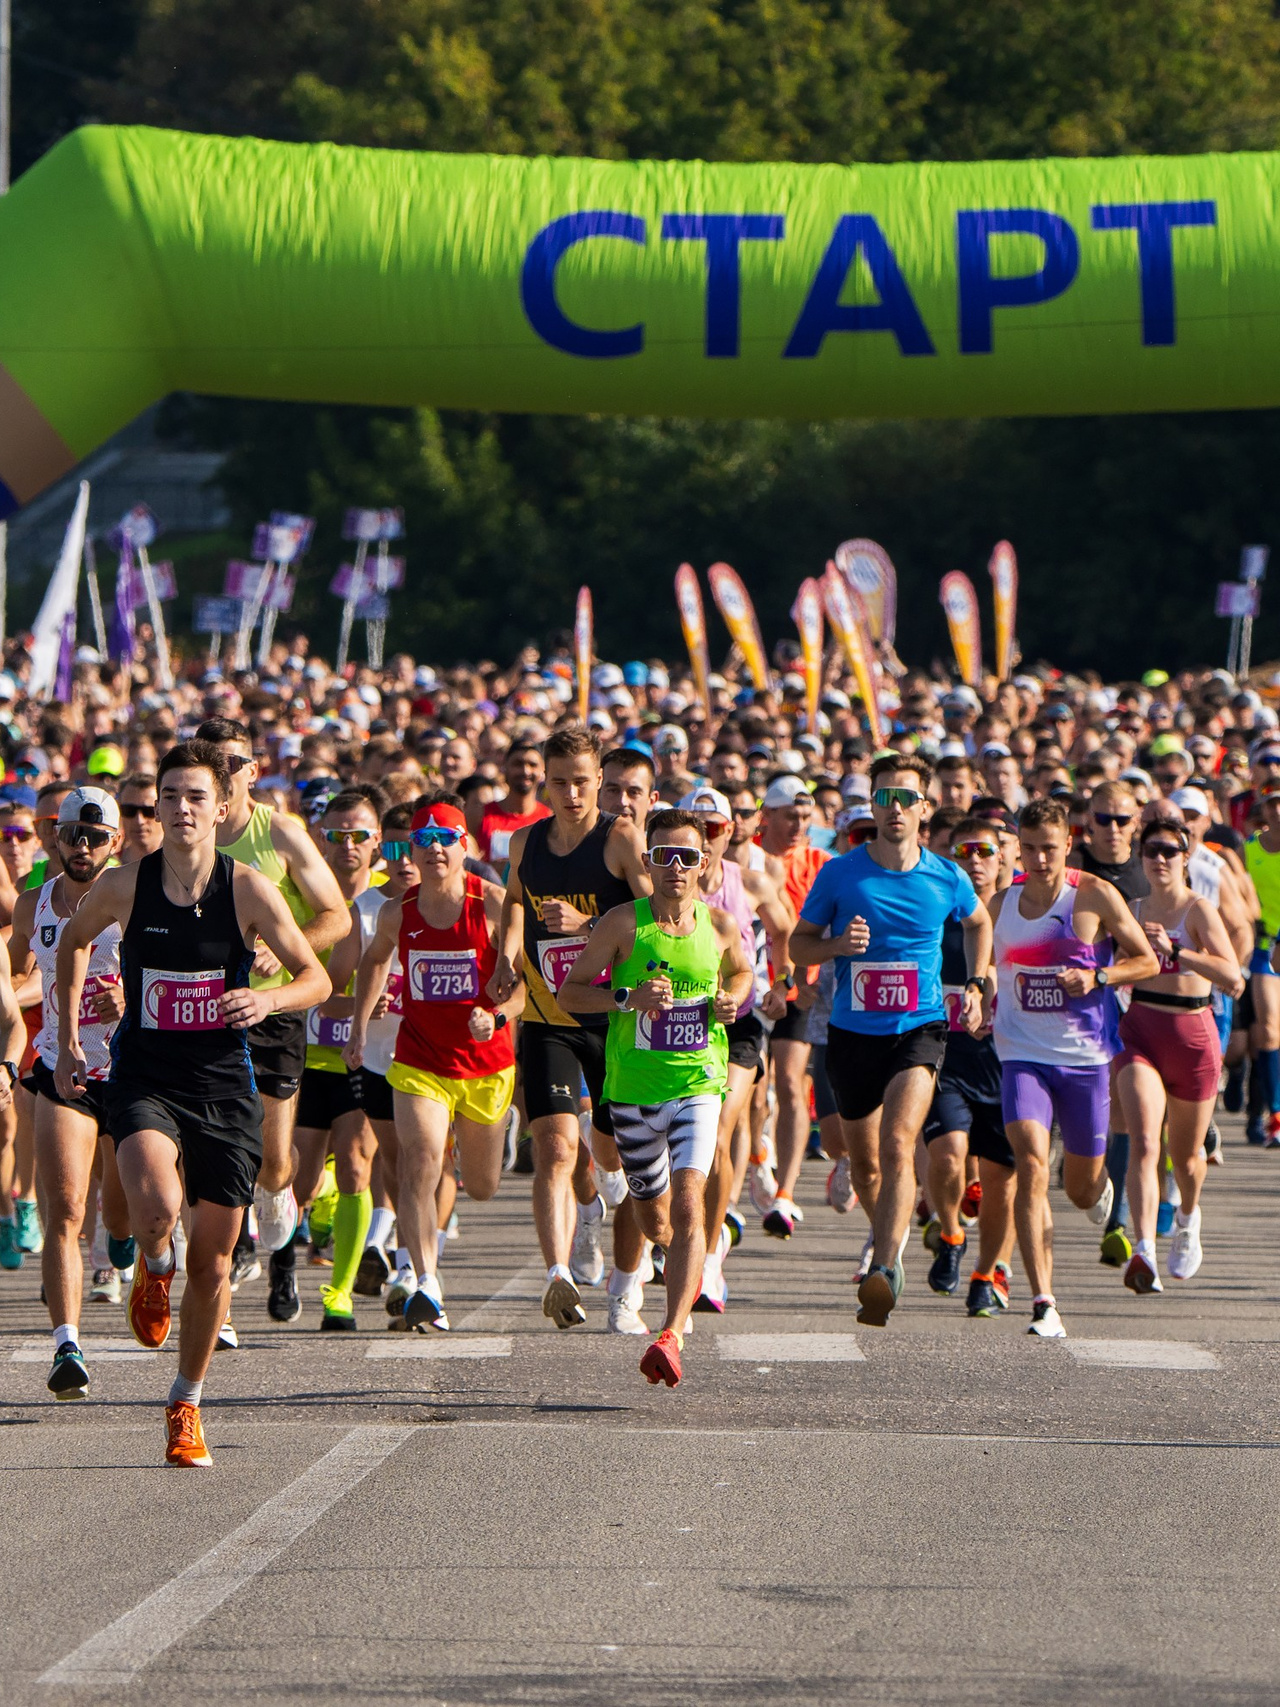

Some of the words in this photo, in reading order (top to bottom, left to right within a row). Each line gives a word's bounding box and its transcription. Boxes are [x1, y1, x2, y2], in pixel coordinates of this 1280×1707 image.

[522, 200, 1216, 359] СТАРТ
[429, 963, 472, 974] АЛЕКСАНДР
[431, 974, 474, 995] 2734
[880, 974, 905, 985] ПАВЕЛ
[176, 986, 211, 998] КИРИЛЛ
[877, 985, 909, 1006] 370
[1026, 988, 1063, 1007] 2850
[171, 998, 218, 1024] 1818
[668, 1009, 701, 1022] АЛЕКСЕЙ
[664, 1022, 704, 1046] 1283
